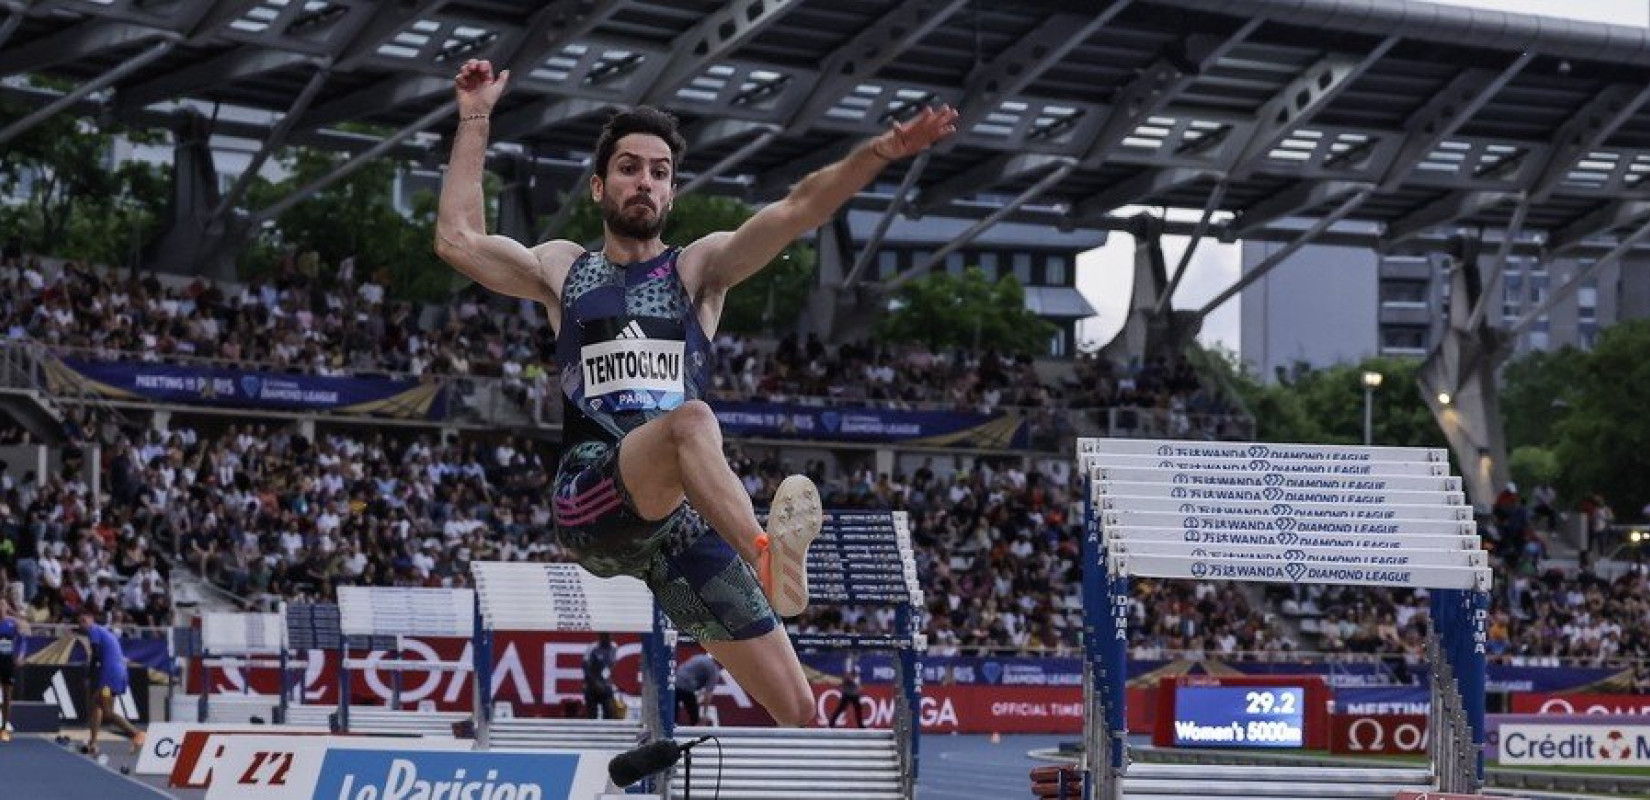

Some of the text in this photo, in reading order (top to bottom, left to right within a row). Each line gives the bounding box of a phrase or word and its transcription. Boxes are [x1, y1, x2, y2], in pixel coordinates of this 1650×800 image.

[586, 350, 679, 385] TENTOGLOU
[1308, 567, 1363, 581] DIAMOND
[1365, 570, 1411, 582] LEAGUE
[860, 697, 959, 726] OMGA
[991, 702, 1048, 716] OFFICIAL
[1245, 691, 1295, 714] 29.2
[1174, 720, 1302, 742] Women's 5000m
[1505, 732, 1595, 759] Crédit
